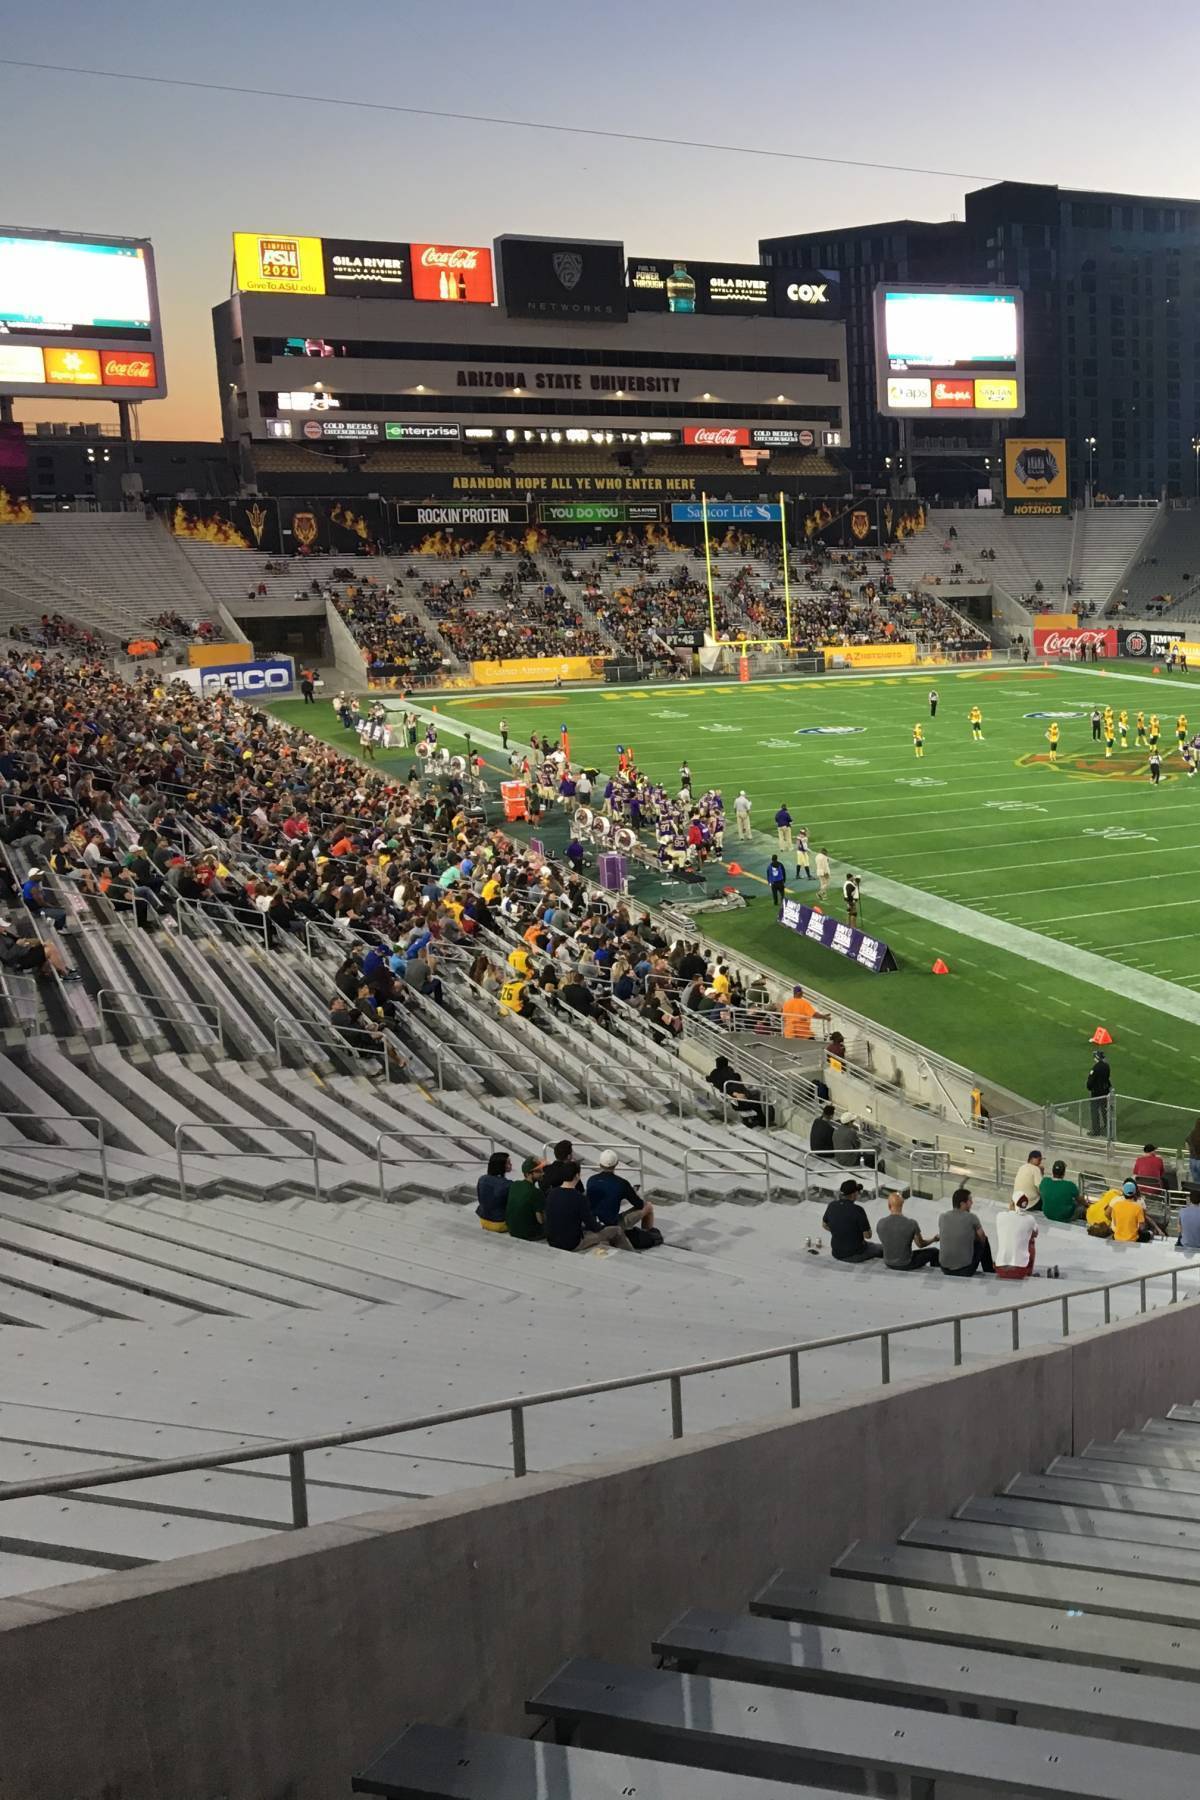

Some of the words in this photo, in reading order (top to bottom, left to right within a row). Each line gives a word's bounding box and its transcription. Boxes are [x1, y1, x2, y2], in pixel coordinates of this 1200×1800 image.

[263, 250, 297, 266] ASU
[333, 256, 362, 266] GILA
[364, 258, 401, 269] RIVER
[421, 247, 479, 269] Coca-Cola
[263, 266, 298, 277] 2020
[636, 271, 659, 280] POWER
[632, 279, 664, 288] THROUGH
[710, 278, 734, 287] GILA
[736, 279, 766, 289] RIVER
[787, 283, 827, 303] COX
[528, 302, 613, 313] NETWORKS
[105, 360, 151, 378] Coca-Cola
[456, 370, 527, 388] ARIZONA
[535, 373, 582, 389] STATE
[590, 375, 680, 392] UNIVERSITY
[906, 387, 928, 399] aps
[346, 422, 372, 430] BEERS
[388, 427, 457, 437] enterprise
[694, 428, 738, 445] Coca-Cola
[453, 477, 511, 489] ABANDON
[515, 477, 547, 490] HOPE
[551, 478, 572, 490] ALL
[577, 478, 591, 490] YE
[595, 478, 622, 490] WHO
[626, 479, 662, 490] ENTER
[666, 479, 696, 490] HERE
[462, 508, 509, 523] PROTEIN
[550, 508, 574, 518] YOU
[577, 508, 593, 518] DO
[595, 507, 618, 518] YOU
[732, 506, 753, 518] Life
[1013, 505, 1062, 514] HOTSHOTS
[203, 668, 289, 691] GEICO
